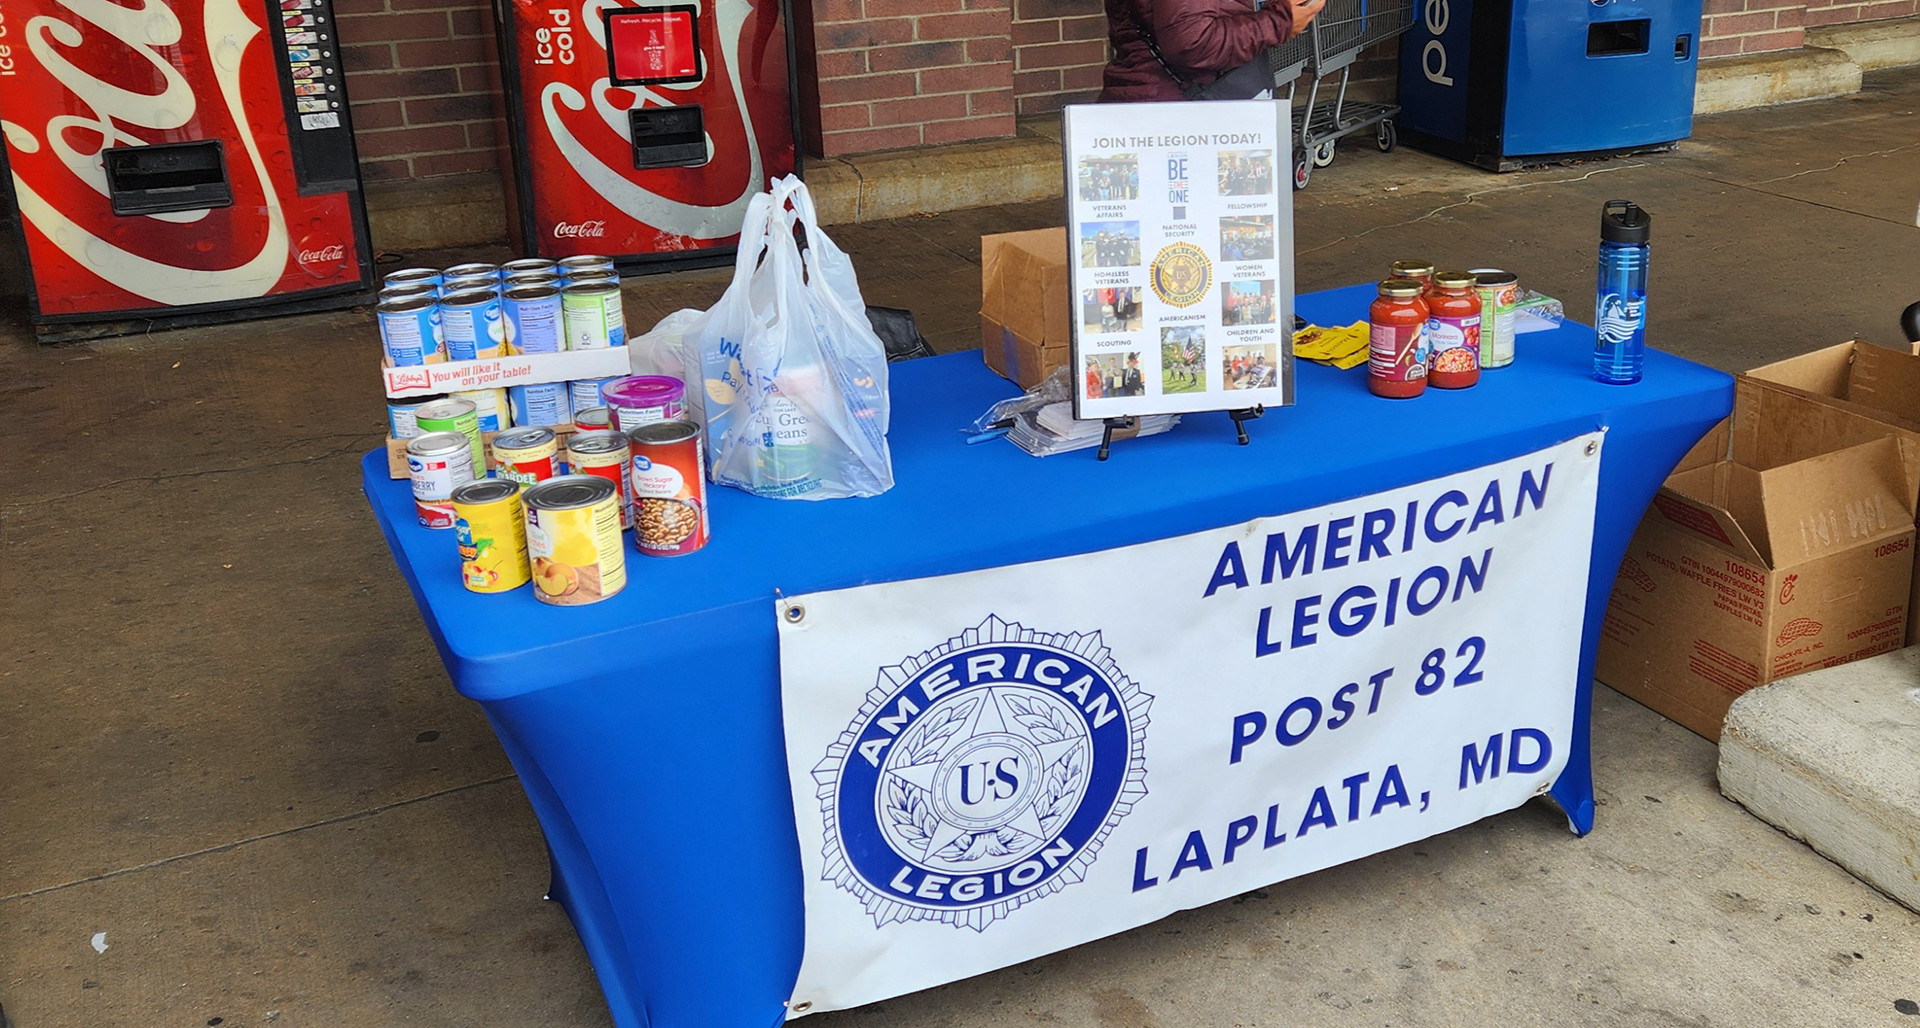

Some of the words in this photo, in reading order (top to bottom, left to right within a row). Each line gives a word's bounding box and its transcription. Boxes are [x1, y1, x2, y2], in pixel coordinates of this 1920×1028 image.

[535, 27, 554, 65] ice
[550, 9, 575, 65] cold
[1092, 137, 1126, 149] JOIN
[1129, 136, 1153, 147] THE
[1158, 135, 1208, 147] LEGION
[1211, 133, 1262, 145] TODAY!
[1168, 159, 1188, 180] BE
[1173, 181, 1185, 189] THE
[1168, 190, 1189, 203] ONE
[554, 220, 605, 238] Coca-Cola
[299, 244, 344, 265] Coca-Cola
[1176, 271, 1187, 280] US
[1158, 314, 1206, 322] AMERICANISM
[1096, 339, 1132, 348] SCOUTING
[1431, 332, 1458, 340] Marinara
[432, 372, 450, 382] You
[452, 368, 470, 378] will
[472, 364, 491, 376] like
[493, 362, 500, 371] it
[461, 376, 474, 386] on
[477, 372, 500, 385] your
[503, 365, 531, 379] table!
[655, 476, 673, 484] Sugar
[1202, 462, 1554, 599] AMERICAN
[1875, 538, 1909, 558] 108654
[1681, 555, 1700, 570] GTIN
[1725, 560, 1766, 586] 108654
[1646, 551, 1678, 573] POTATO,
[1680, 565, 1712, 587] WAFFLE
[1712, 580, 1737, 598] FRIES
[1738, 592, 1751, 604] LW
[1753, 598, 1764, 610] V3
[1255, 547, 1494, 659] LEGION
[1717, 593, 1738, 608] PAPAS
[1885, 604, 1903, 617] GTIN
[1713, 600, 1741, 618] WAFFLES
[1743, 613, 1753, 622] LW
[1754, 618, 1763, 627] V3
[1823, 652, 1854, 668] WAFFLE
[1855, 644, 1877, 659] FRIES
[1878, 641, 1889, 651] LW
[1890, 637, 1900, 647] V3
[858, 652, 1118, 768] AMERICAN
[1229, 667, 1394, 765] POST
[1414, 636, 1486, 697] 82
[1131, 764, 1431, 893] LAPLATA,
[1458, 728, 1553, 790] MD
[889, 835, 1075, 901] LEGION
